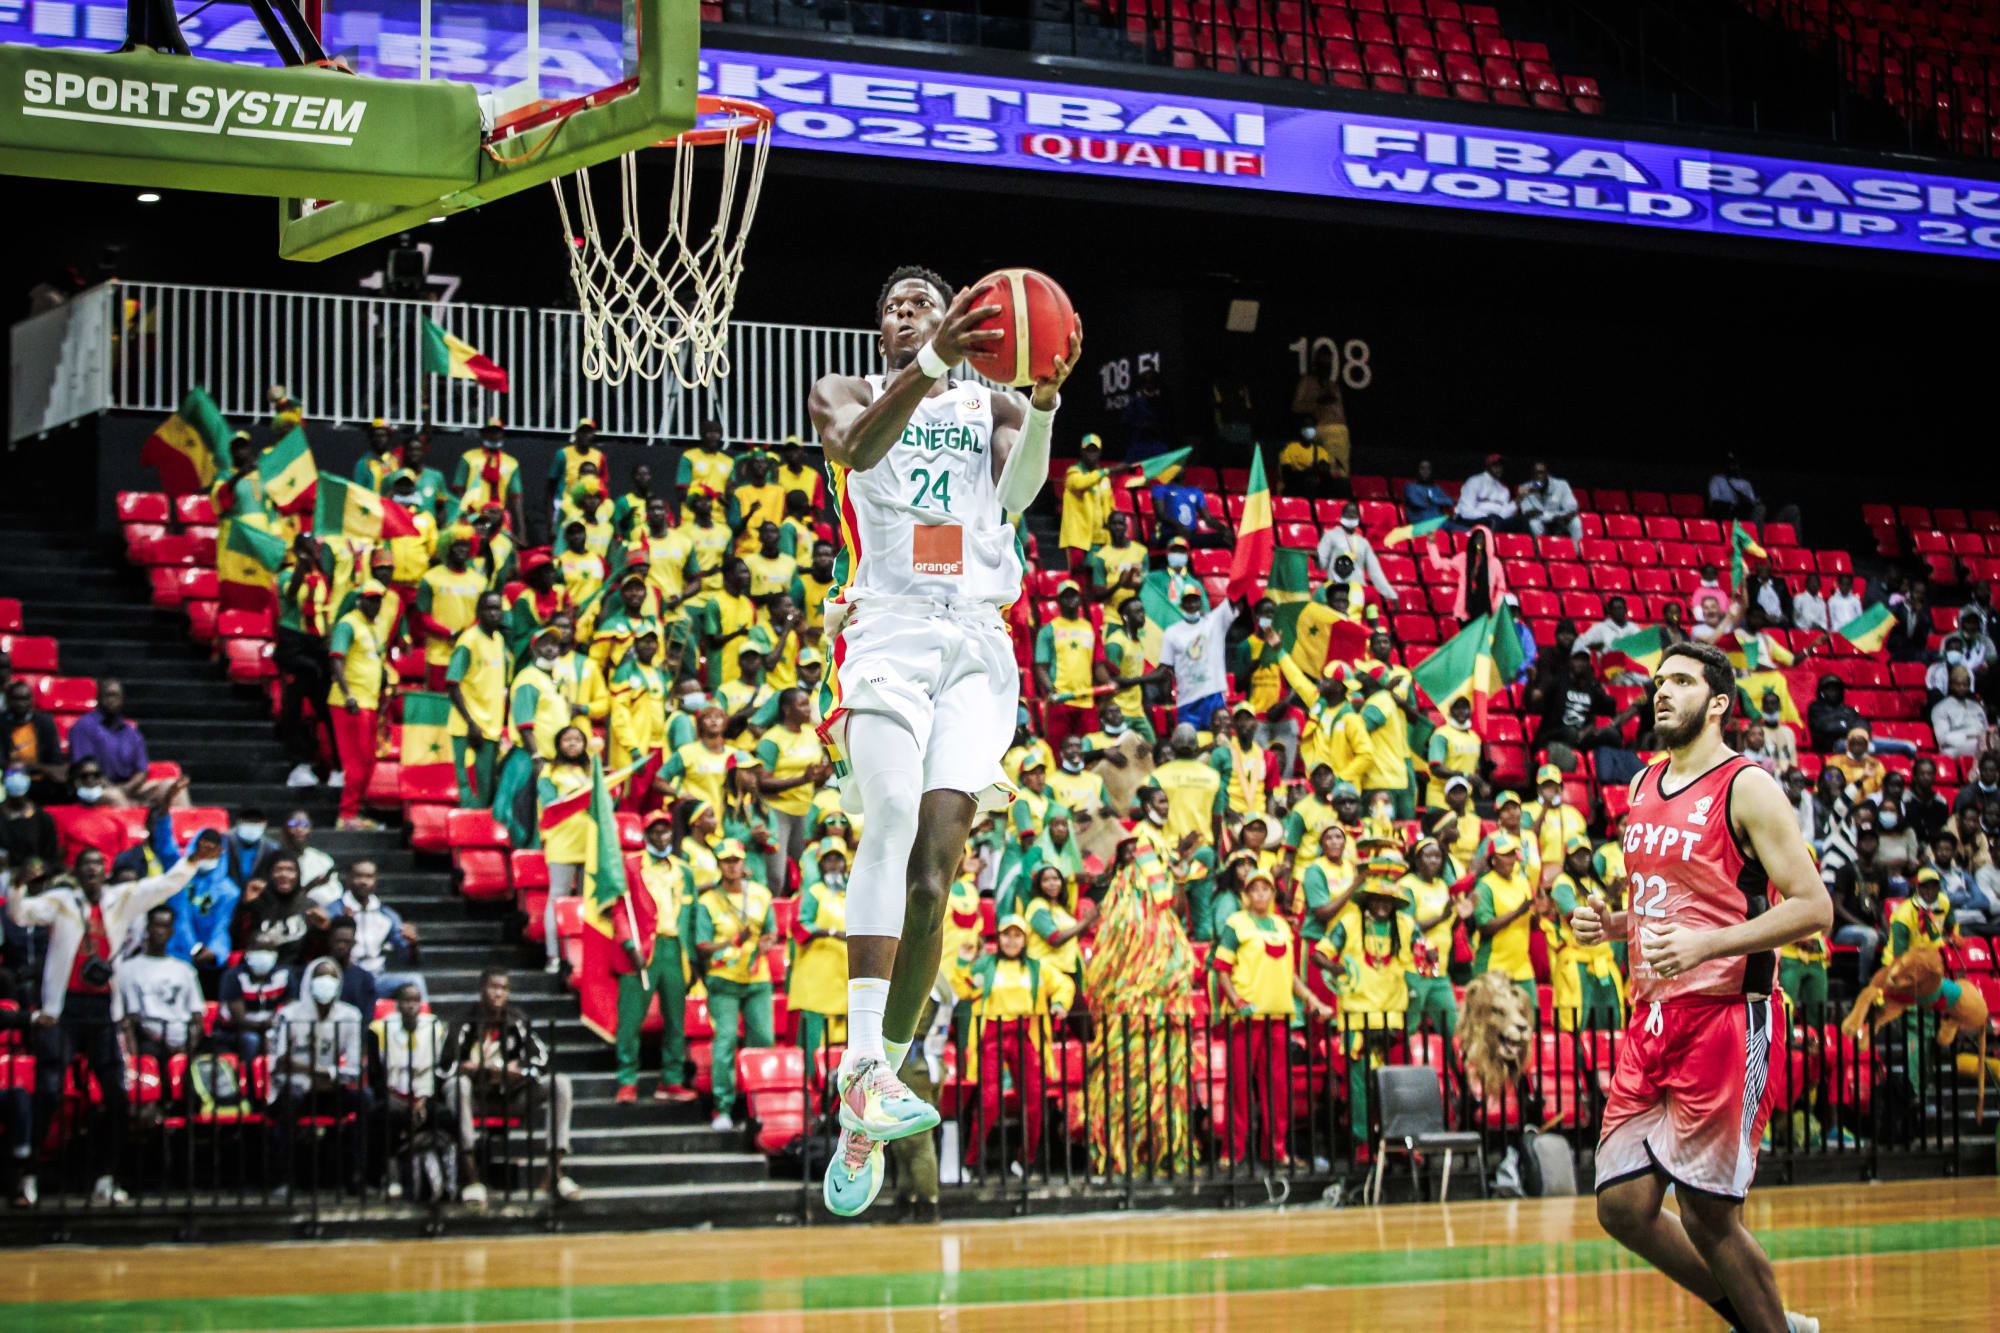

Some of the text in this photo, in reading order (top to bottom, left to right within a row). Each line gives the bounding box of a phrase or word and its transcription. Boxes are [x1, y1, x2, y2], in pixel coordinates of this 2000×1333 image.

[23, 69, 367, 134] SPORT SYSTEM
[704, 109, 999, 152] 023
[1342, 134, 2000, 221] FIBA BASK
[1342, 161, 1694, 218] WORLD
[1718, 201, 1898, 236] CUP
[1100, 358, 1131, 395] 108
[902, 422, 983, 454] ENEGAL
[910, 468, 951, 513] 24
[914, 562, 958, 574] orange
[1631, 871, 1668, 918] 22
